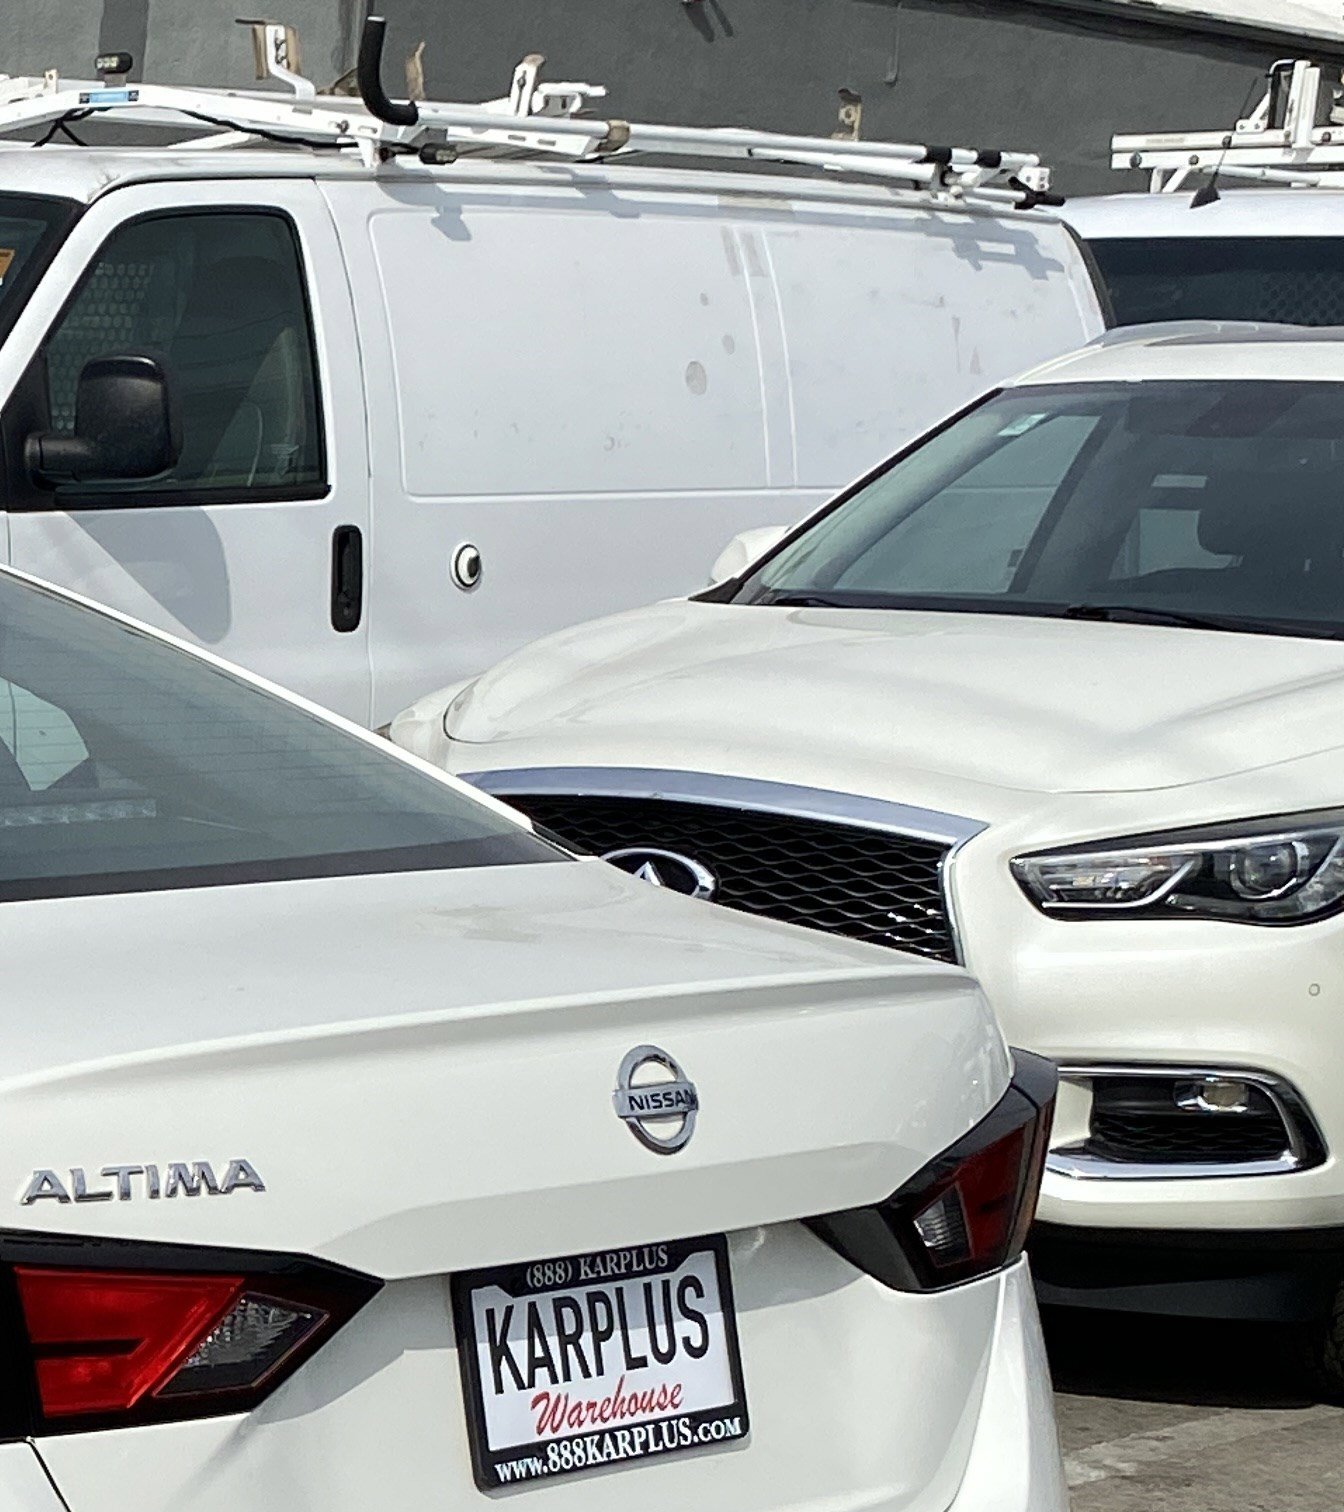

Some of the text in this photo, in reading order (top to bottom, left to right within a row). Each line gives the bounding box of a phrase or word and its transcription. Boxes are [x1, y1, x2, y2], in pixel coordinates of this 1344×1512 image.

[628, 1089, 696, 1111] NISSAN
[20, 1158, 267, 1206] ALTIMA
[525, 1244, 669, 1289] (888) KARPLUS
[485, 1273, 710, 1396] KARPLUS
[530, 1374, 685, 1436] Warehouse
